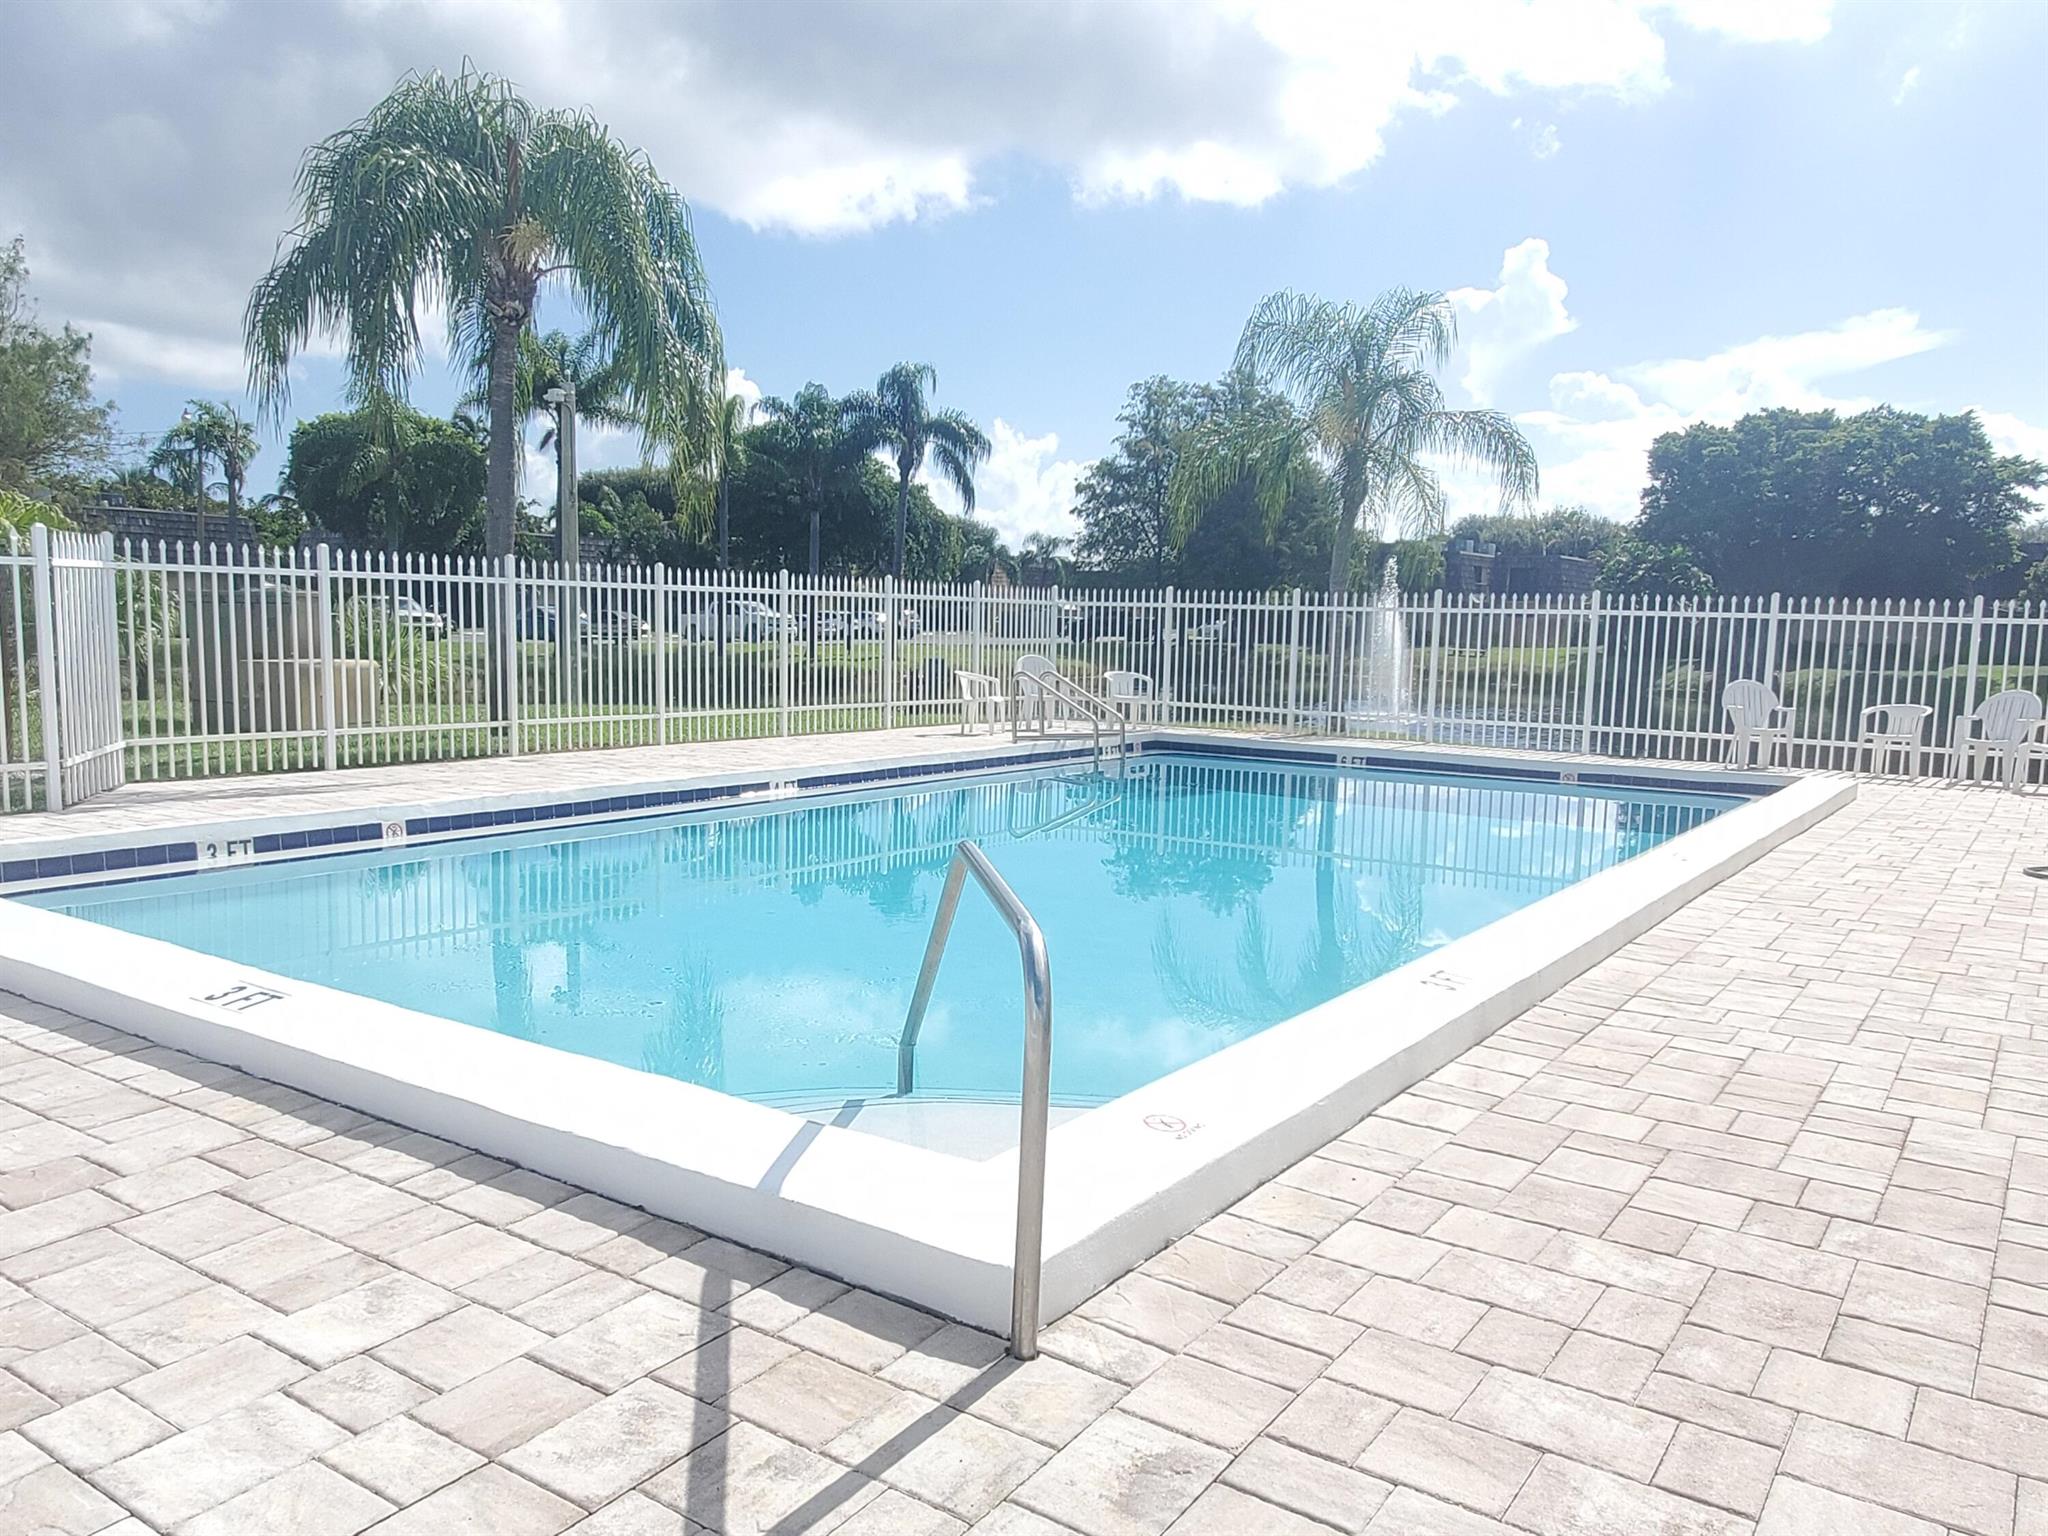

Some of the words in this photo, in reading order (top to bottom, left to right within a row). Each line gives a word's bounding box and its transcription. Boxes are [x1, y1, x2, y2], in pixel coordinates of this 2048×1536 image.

[206, 842, 218, 859] 3
[226, 839, 252, 857] FT
[203, 985, 248, 1001] 3
[221, 991, 285, 1011] FT
